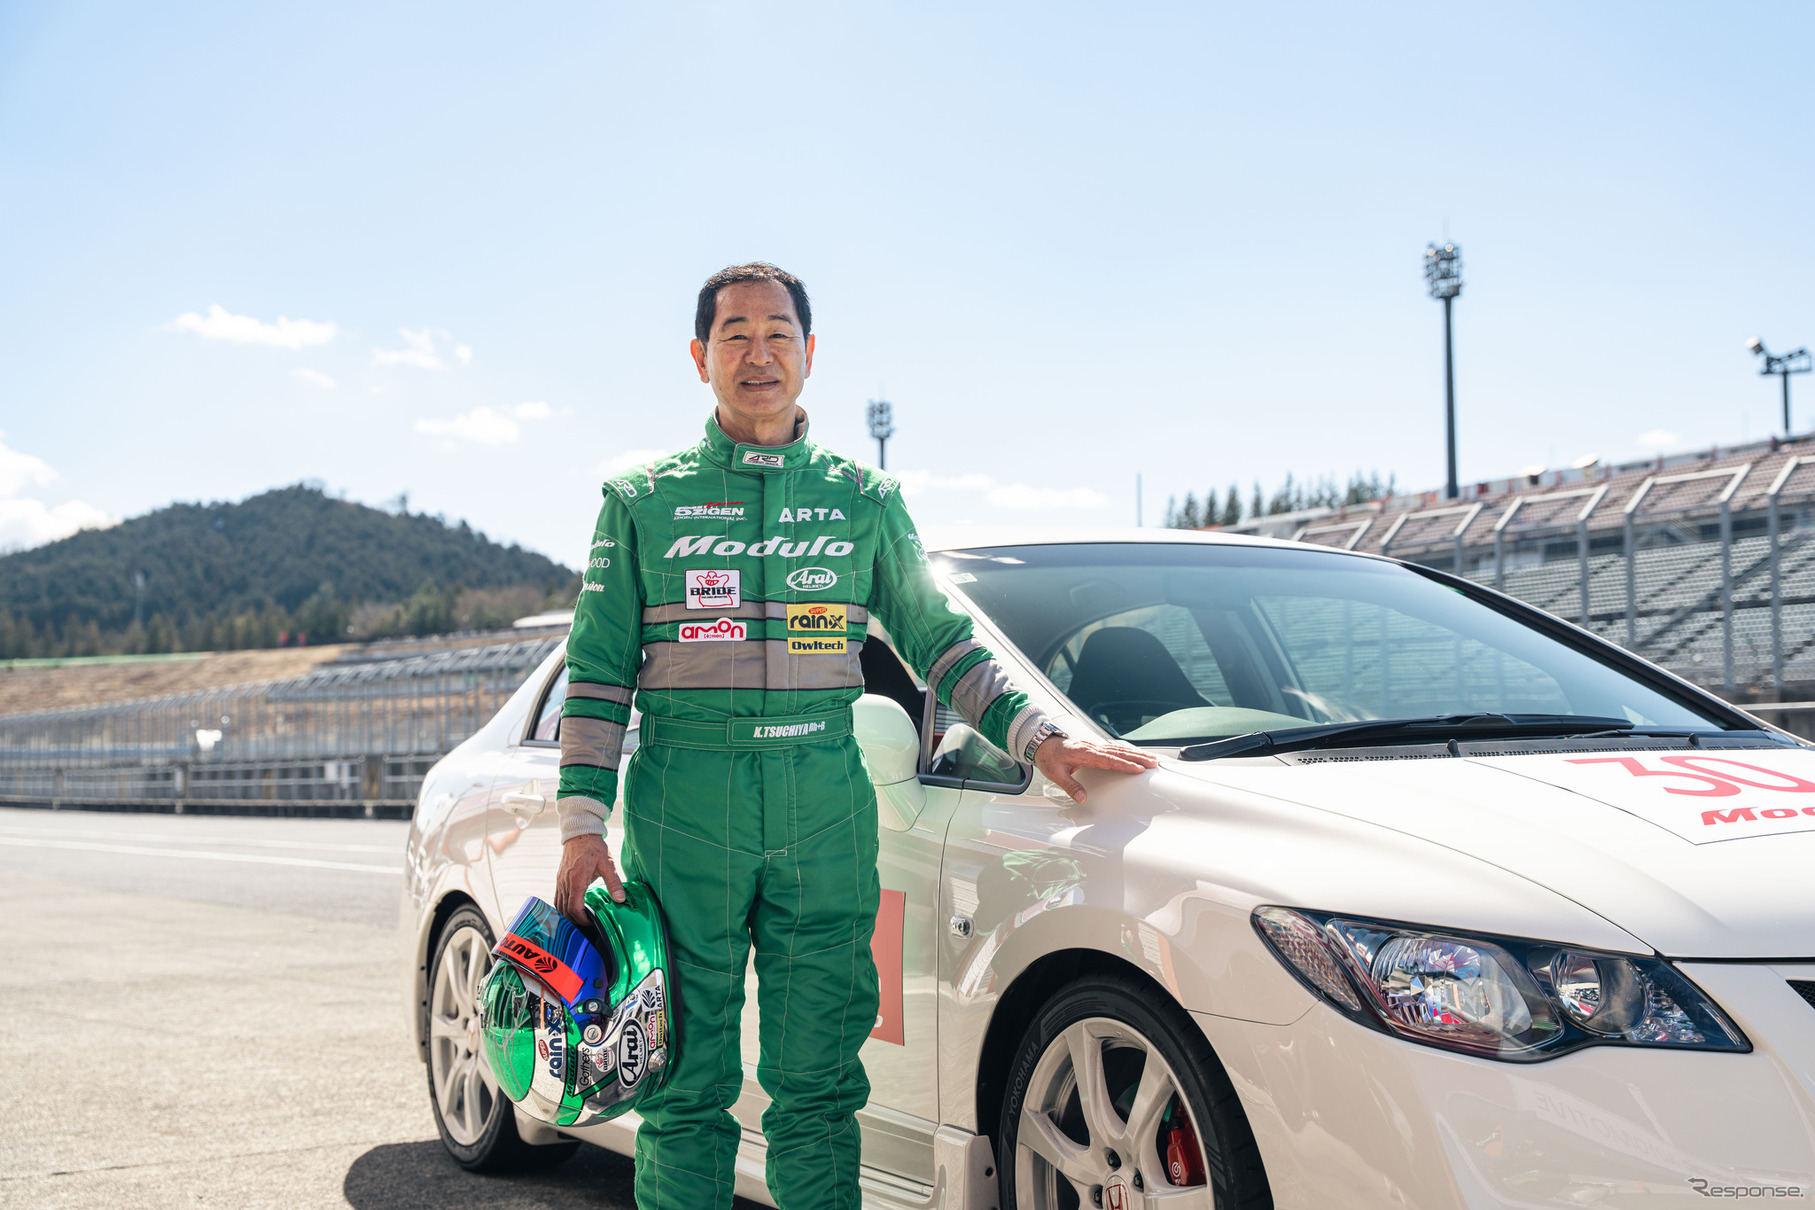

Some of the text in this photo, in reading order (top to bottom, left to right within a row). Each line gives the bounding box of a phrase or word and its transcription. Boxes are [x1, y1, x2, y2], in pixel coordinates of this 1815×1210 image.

[778, 507, 847, 523] ARTA
[662, 535, 855, 558] Modulo
[790, 569, 833, 585] Arai
[690, 586, 737, 596] BRIDE
[681, 620, 744, 639] amon
[792, 641, 844, 650] Owltech
[753, 723, 808, 738] K.TSUCHIYA
[648, 1015, 656, 1049] amon
[622, 1026, 639, 1080] Arai
[566, 1045, 576, 1097] Modulo
[579, 1046, 591, 1086] Gathers
[1008, 1041, 1040, 1117] YOKOHAMA
